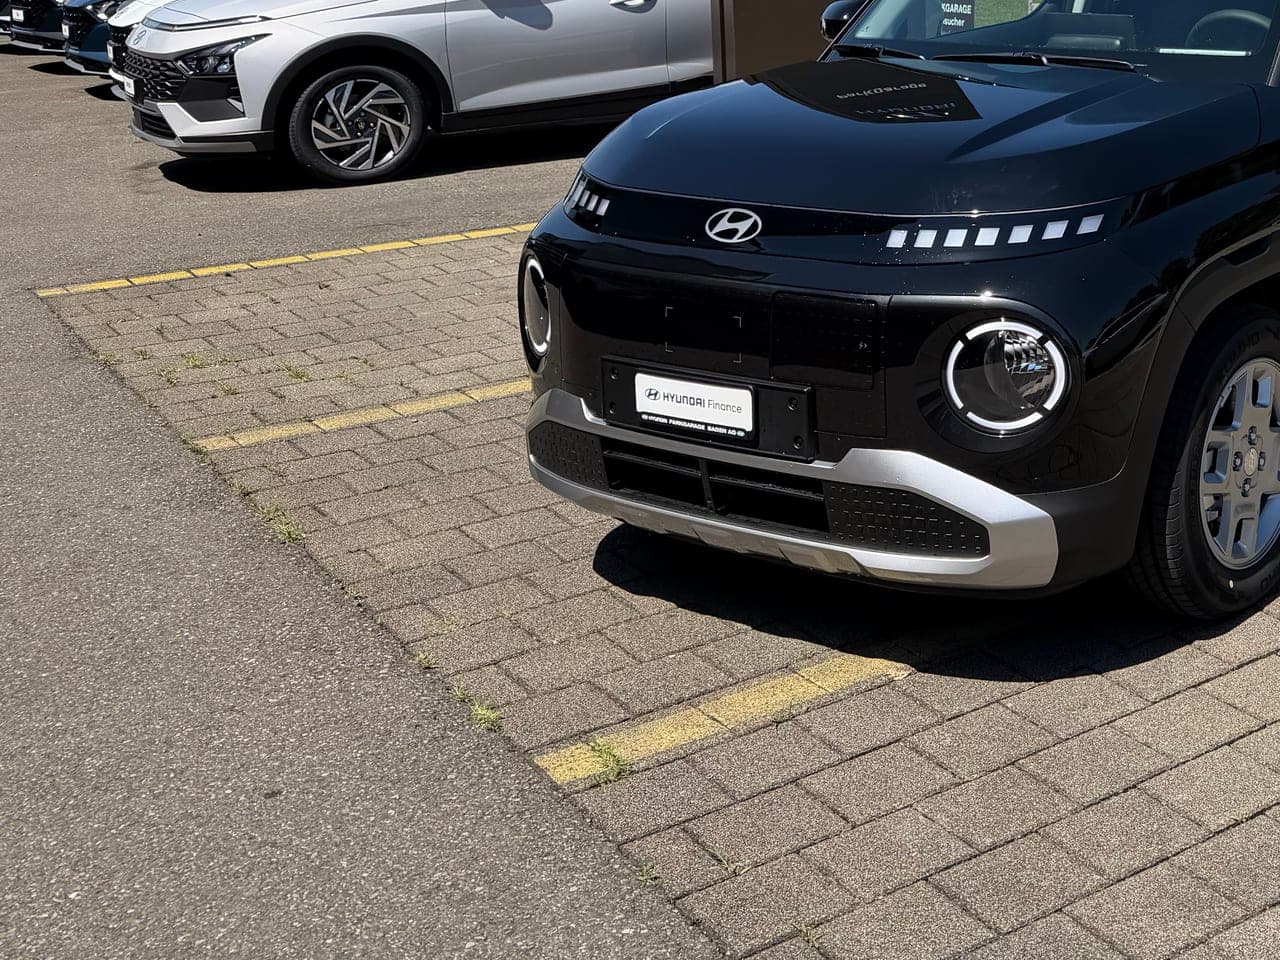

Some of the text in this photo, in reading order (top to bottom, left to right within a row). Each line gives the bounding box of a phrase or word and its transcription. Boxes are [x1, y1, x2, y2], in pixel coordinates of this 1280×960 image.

[941, 3, 972, 14] KGARAGE
[662, 392, 742, 413] HYUNDAI Finance
